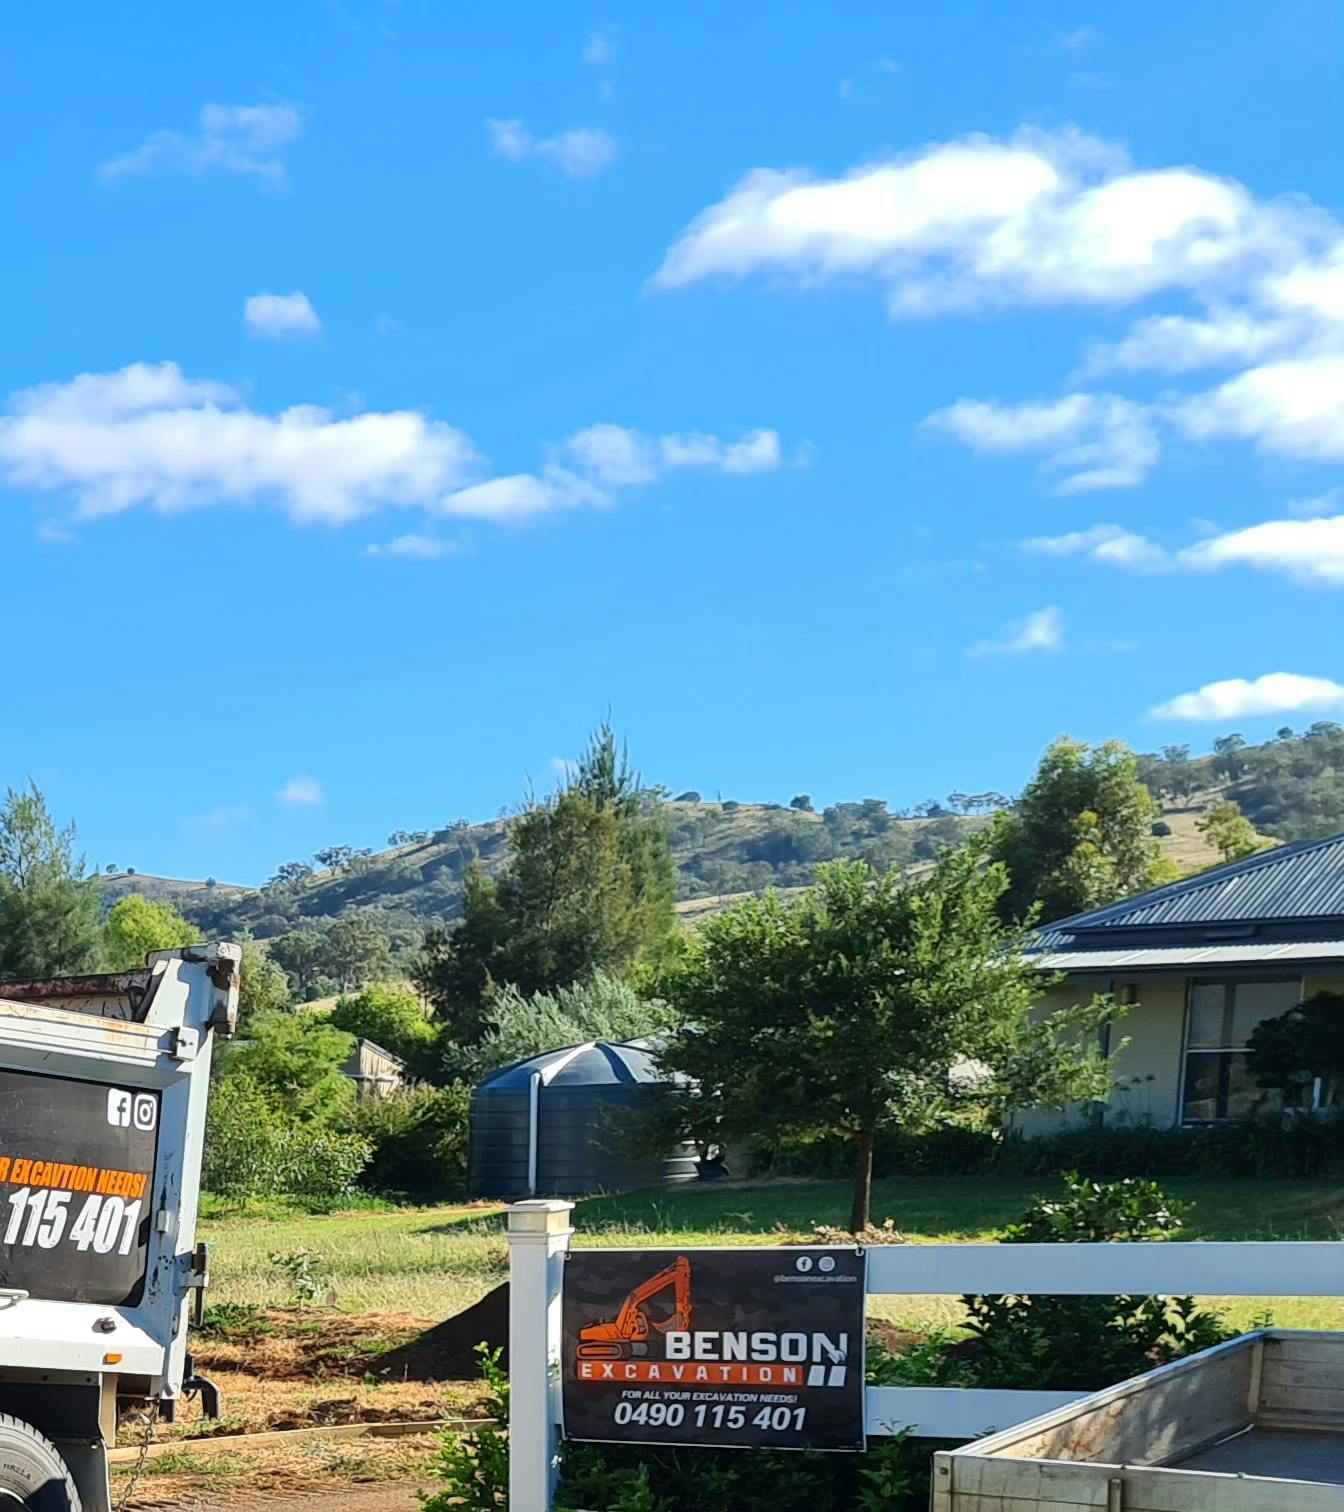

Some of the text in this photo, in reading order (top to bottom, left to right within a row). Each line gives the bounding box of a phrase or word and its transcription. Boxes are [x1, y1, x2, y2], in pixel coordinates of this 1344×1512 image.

[9, 1158, 99, 1193] EXCAVTION
[96, 1168, 149, 1199] NEEDS!
[3, 1187, 72, 1249] 115
[69, 1194, 143, 1256] 401
[665, 1331, 848, 1364] BENSON
[580, 1363, 797, 1380] EXCAVATION
[621, 1390, 798, 1404] FOR ALL YOUR EXCAVATION NEEDS!
[614, 1402, 806, 1431] 0490 115 401
